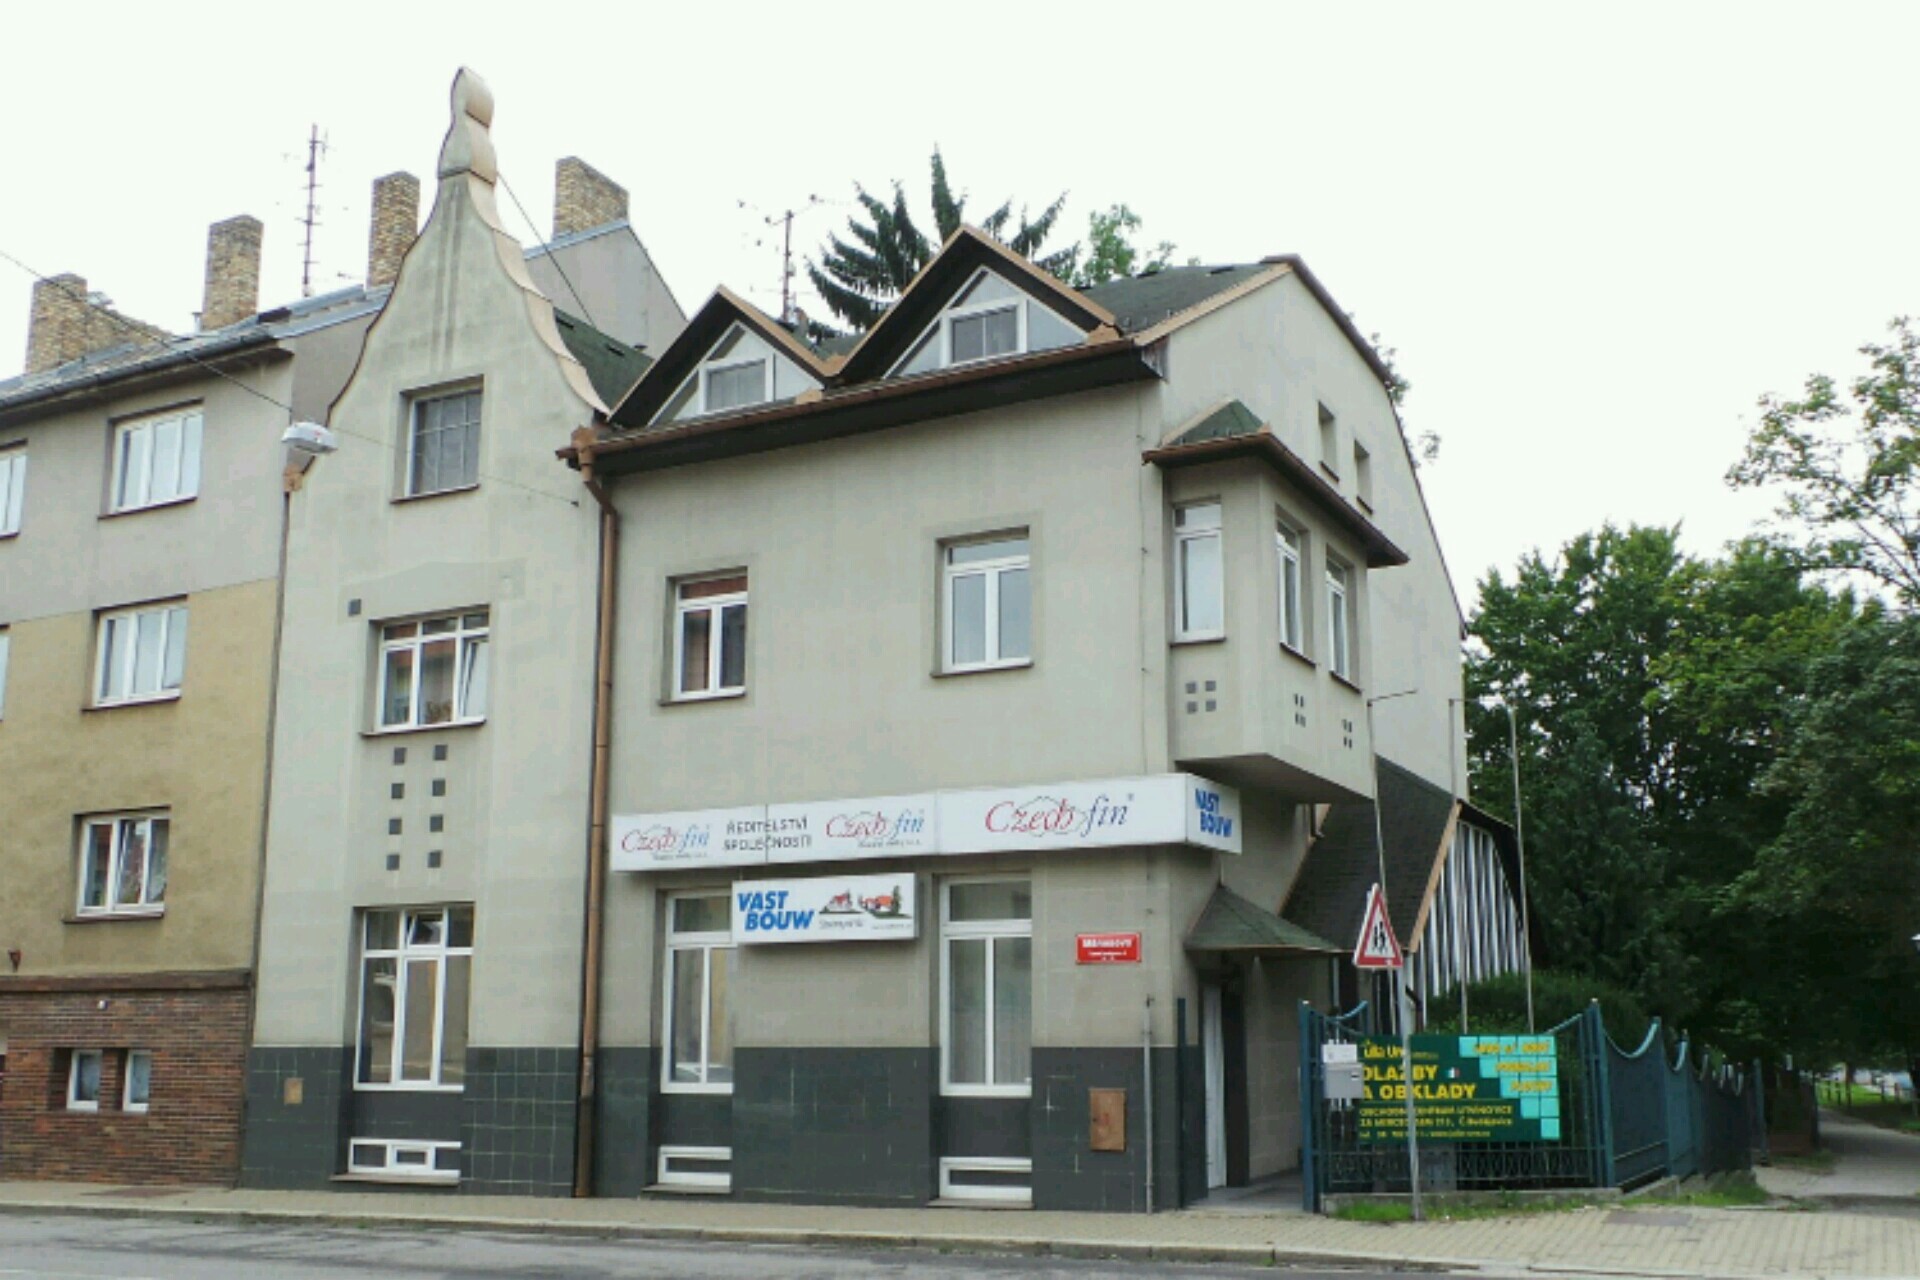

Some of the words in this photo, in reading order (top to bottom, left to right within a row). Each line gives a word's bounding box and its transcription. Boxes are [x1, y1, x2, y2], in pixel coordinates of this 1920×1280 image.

[1194, 788, 1220, 814] VAST
[726, 815, 808, 835] ŘEDITELSTVÍ
[1200, 810, 1232, 838] BOUW
[737, 890, 789, 912] VAST
[745, 909, 815, 931] BOUW
[1379, 1083, 1476, 1100] OBKLADY
